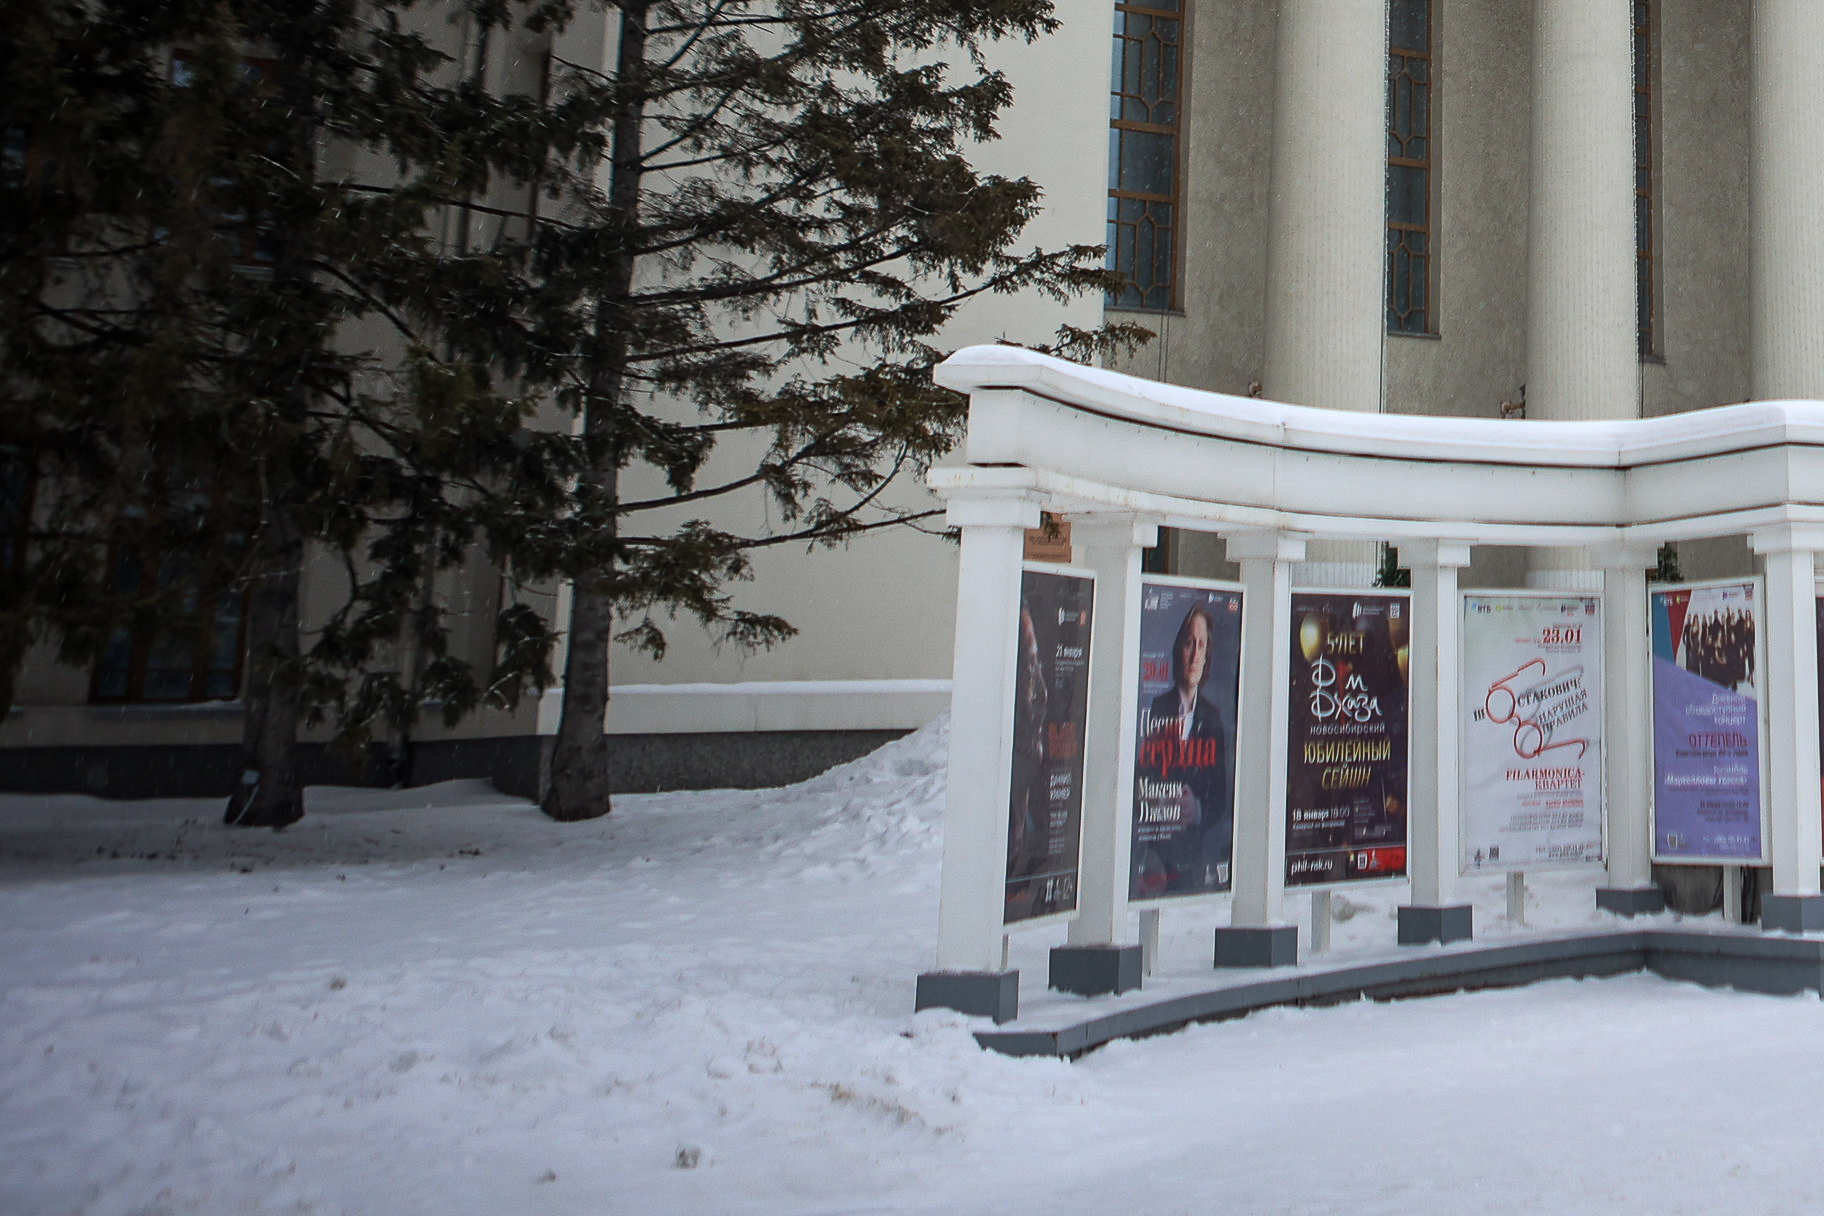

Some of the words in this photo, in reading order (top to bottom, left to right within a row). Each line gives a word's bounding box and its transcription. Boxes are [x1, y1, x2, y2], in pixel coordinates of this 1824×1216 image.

[1542, 628, 1582, 644] 23.01
[1303, 737, 1392, 765] ЮБИЛЕЙНЫЙ
[1303, 808, 1329, 822] января
